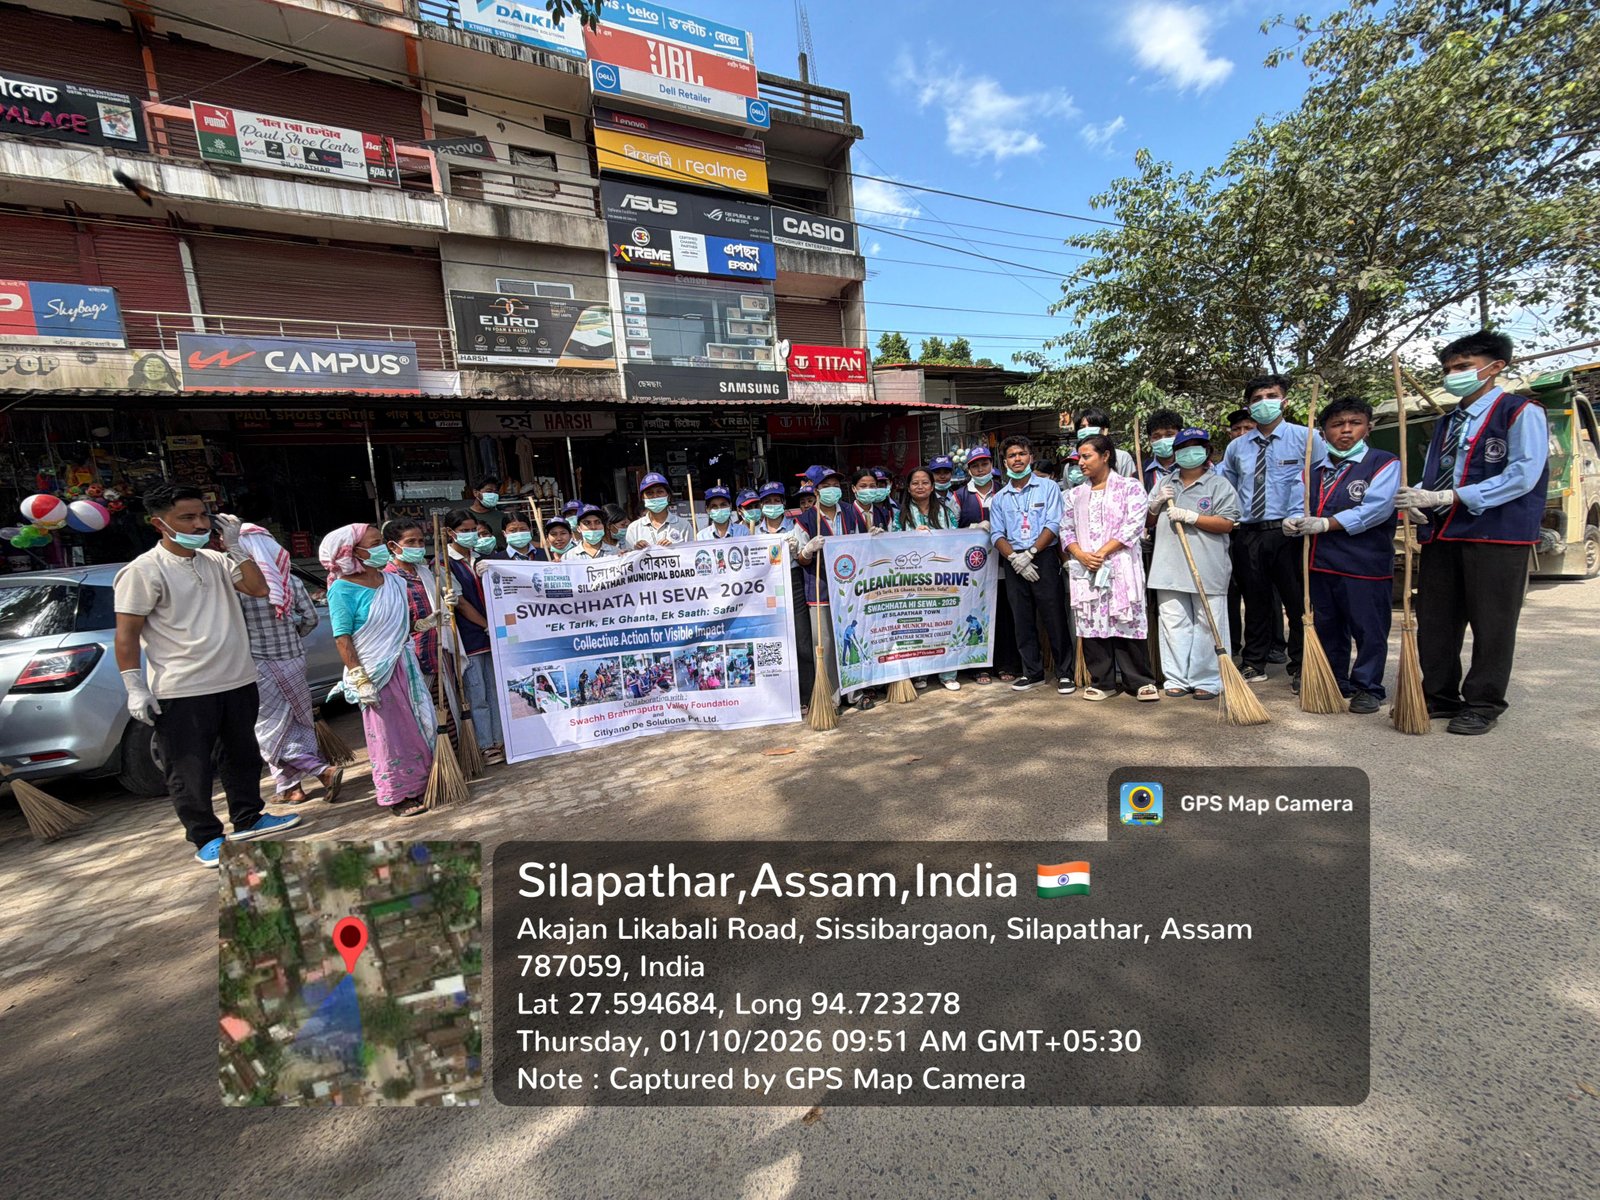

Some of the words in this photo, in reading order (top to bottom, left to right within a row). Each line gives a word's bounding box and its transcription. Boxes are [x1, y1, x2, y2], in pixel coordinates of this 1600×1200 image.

[496, 5, 565, 32] DAIKIN
[626, 3, 659, 21] beko
[469, 23, 492, 34] XTREME
[495, 28, 517, 40] SYSTEM
[647, 42, 704, 86] JBL
[598, 73, 614, 82] DELL
[659, 84, 677, 97] Dell
[678, 88, 712, 104] Retailer
[751, 107, 765, 117] DELL
[615, 115, 646, 129] Lenovo
[240, 124, 279, 143] Paul
[281, 131, 317, 147] Shoe
[320, 138, 360, 155] Centre
[685, 158, 748, 182] realme
[620, 193, 678, 216] ASUS
[782, 216, 845, 243] CASIO
[613, 243, 672, 262] XTREME
[805, 242, 833, 252] ENTERPRISE
[728, 260, 758, 273] EPSON
[674, 273, 708, 286] Canon
[43, 298, 109, 322] Skybags
[479, 315, 539, 328] EURO
[460, 354, 488, 363] HARSH
[814, 355, 862, 372] TITAN
[719, 381, 780, 395] SAMSUNG
[235, 410, 271, 422] PAUL
[275, 410, 322, 422] SHOES
[544, 414, 592, 430] HARSH
[797, 415, 830, 427] TITAN
[577, 574, 626, 594] SILAPATHAR
[627, 570, 668, 584] MUNICIPAL
[669, 568, 696, 578] BOARD
[854, 572, 933, 597] CLEANLINESS
[935, 572, 970, 587] DRIVE
[516, 592, 636, 620] SWACHHATA
[639, 590, 657, 606] HI
[662, 586, 709, 604] SEVA
[720, 579, 766, 598] 2026
[867, 601, 907, 614] SWACHHATA
[908, 602, 916, 610] HI
[917, 599, 937, 609] SEWA
[941, 598, 957, 607] 2026
[601, 615, 616, 627] Ek
[618, 612, 658, 625] Ghanta,
[661, 611, 675, 620] Ek
[677, 607, 710, 619] Saath:
[889, 609, 922, 618] SILAPATHAR
[870, 623, 900, 635] SILAPATHAR
[902, 621, 934, 630] MUNICIPAL
[935, 620, 953, 628] BOARD
[573, 631, 619, 651] Collective
[621, 628, 648, 646] Action
[650, 630, 663, 643] for
[664, 625, 694, 642] Visible
[694, 622, 726, 640] Impact
[569, 714, 605, 727] Swachh
[607, 704, 664, 720] Brahmaputra
[666, 701, 689, 712] Valley
[691, 698, 739, 710] Foundation
[593, 723, 630, 738] Citiyano
[632, 721, 644, 730] De
[646, 716, 685, 728] Solutions
[688, 715, 702, 724] Pvt.
[703, 715, 719, 723] Ltd.
